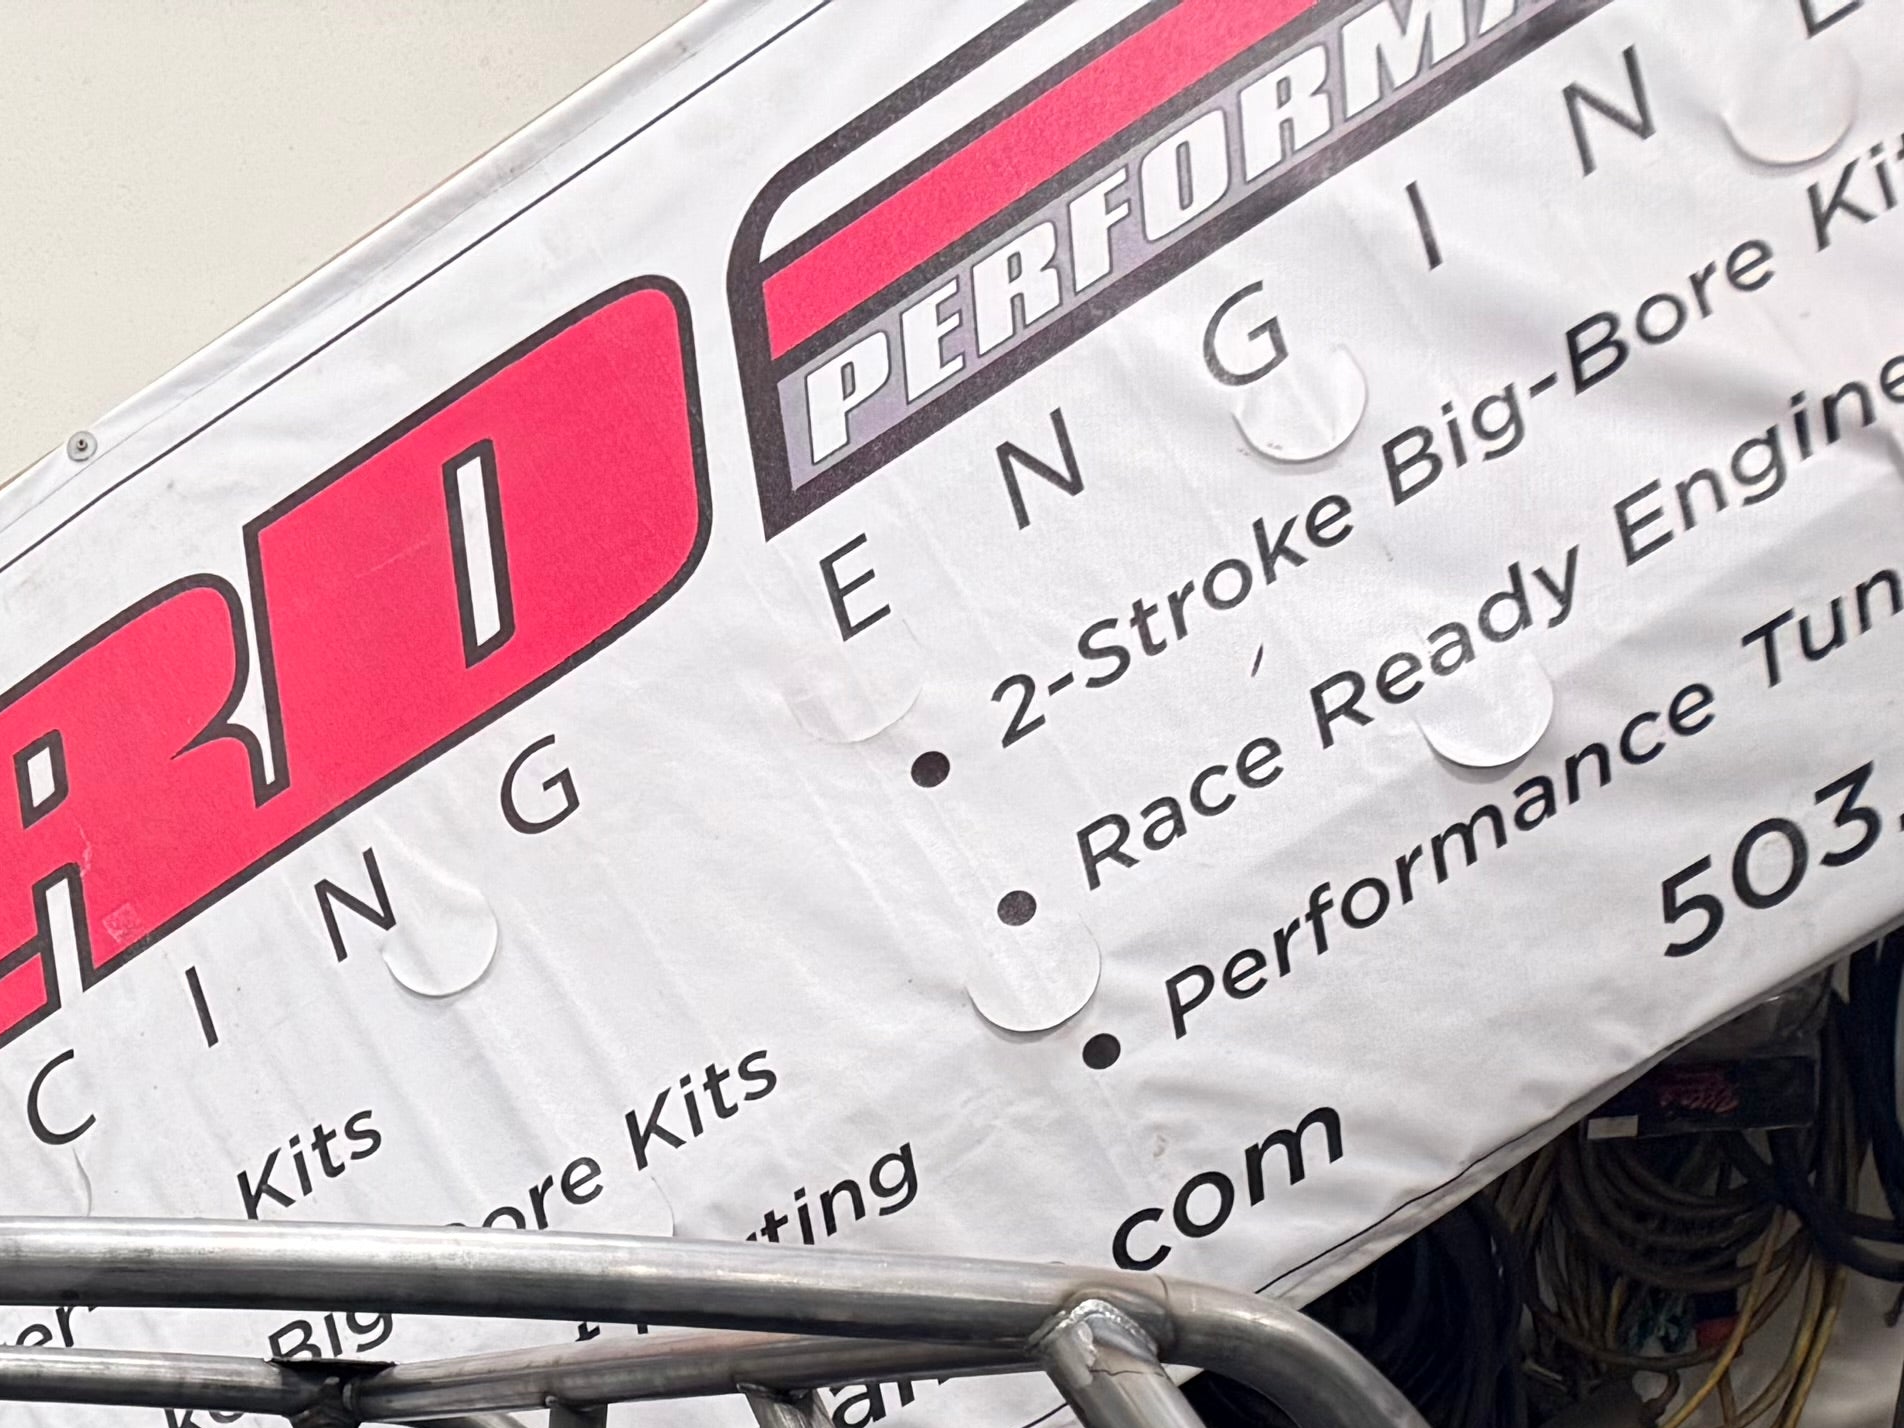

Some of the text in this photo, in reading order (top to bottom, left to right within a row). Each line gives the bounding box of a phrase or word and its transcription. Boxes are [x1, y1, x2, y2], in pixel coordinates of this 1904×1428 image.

[990, 132, 1904, 748] 2-Stroke Big-Bore Ki
[1076, 737, 1283, 890] Race
[1309, 544, 1582, 750] Ready
[1164, 567, 1904, 1040] Performance Tun
[1661, 761, 1904, 959] 503
[236, 1108, 383, 1220] Kits
[624, 1049, 779, 1171] Kits
